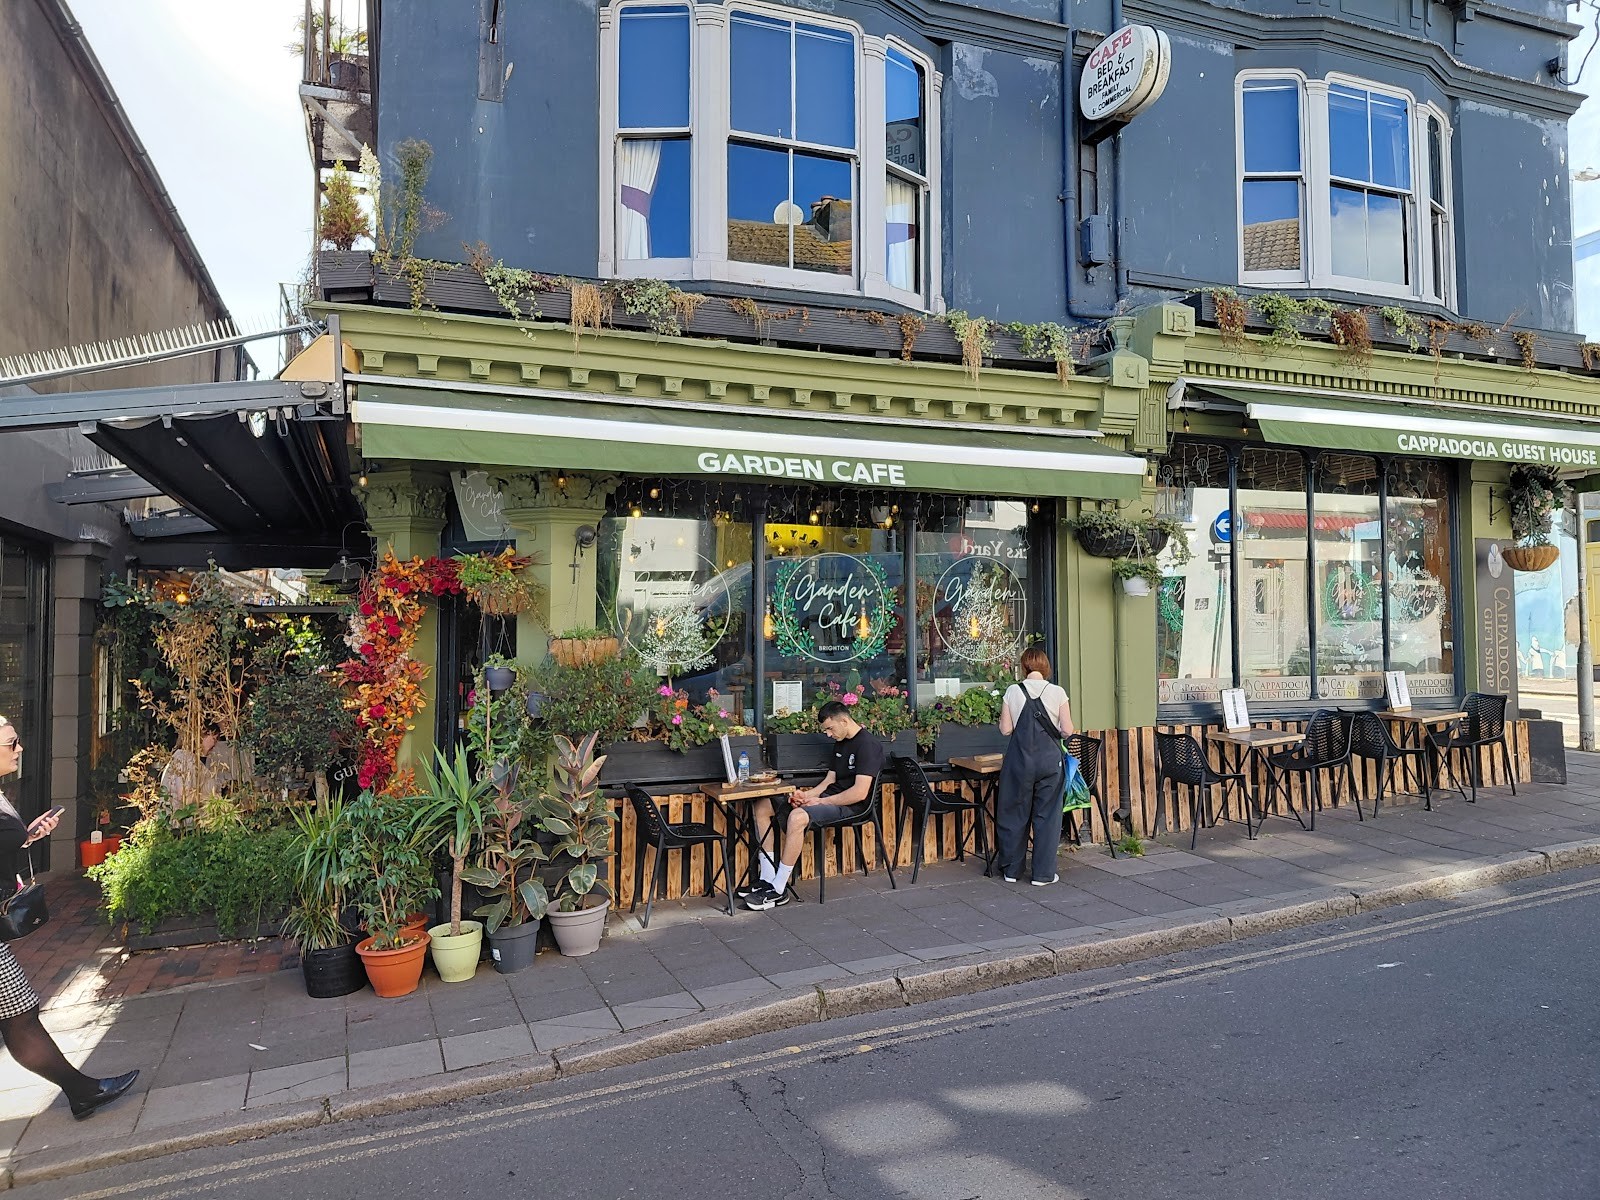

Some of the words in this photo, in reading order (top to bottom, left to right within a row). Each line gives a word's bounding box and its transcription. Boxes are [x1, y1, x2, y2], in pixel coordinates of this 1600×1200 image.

[1089, 28, 1132, 70] CAFE
[1087, 57, 1136, 99] BREAKFAST
[1097, 60, 1113, 79] BED
[1098, 84, 1132, 110] COMMERCIAL
[1101, 82, 1120, 99] FAMILY
[1397, 434, 1499, 458] CAPPADOCIA
[1501, 443, 1545, 461] GUEST
[1550, 447, 1598, 465] HOUSE
[697, 452, 825, 480] GARDEN
[831, 461, 906, 485] CAFE
[633, 571, 719, 610] Gden
[795, 573, 874, 611] Garden
[944, 576, 1017, 612] Garden
[818, 602, 861, 639] Café
[1483, 608, 1494, 645] GIFT
[1409, 678, 1453, 687] APPADOCIA
[1485, 648, 1495, 688] SHOP
[1254, 680, 1310, 691] CAPPADOCIA
[1256, 691, 1281, 700] GUEST
[1283, 690, 1310, 699] HOUSE
[1408, 687, 1428, 695] UEST
